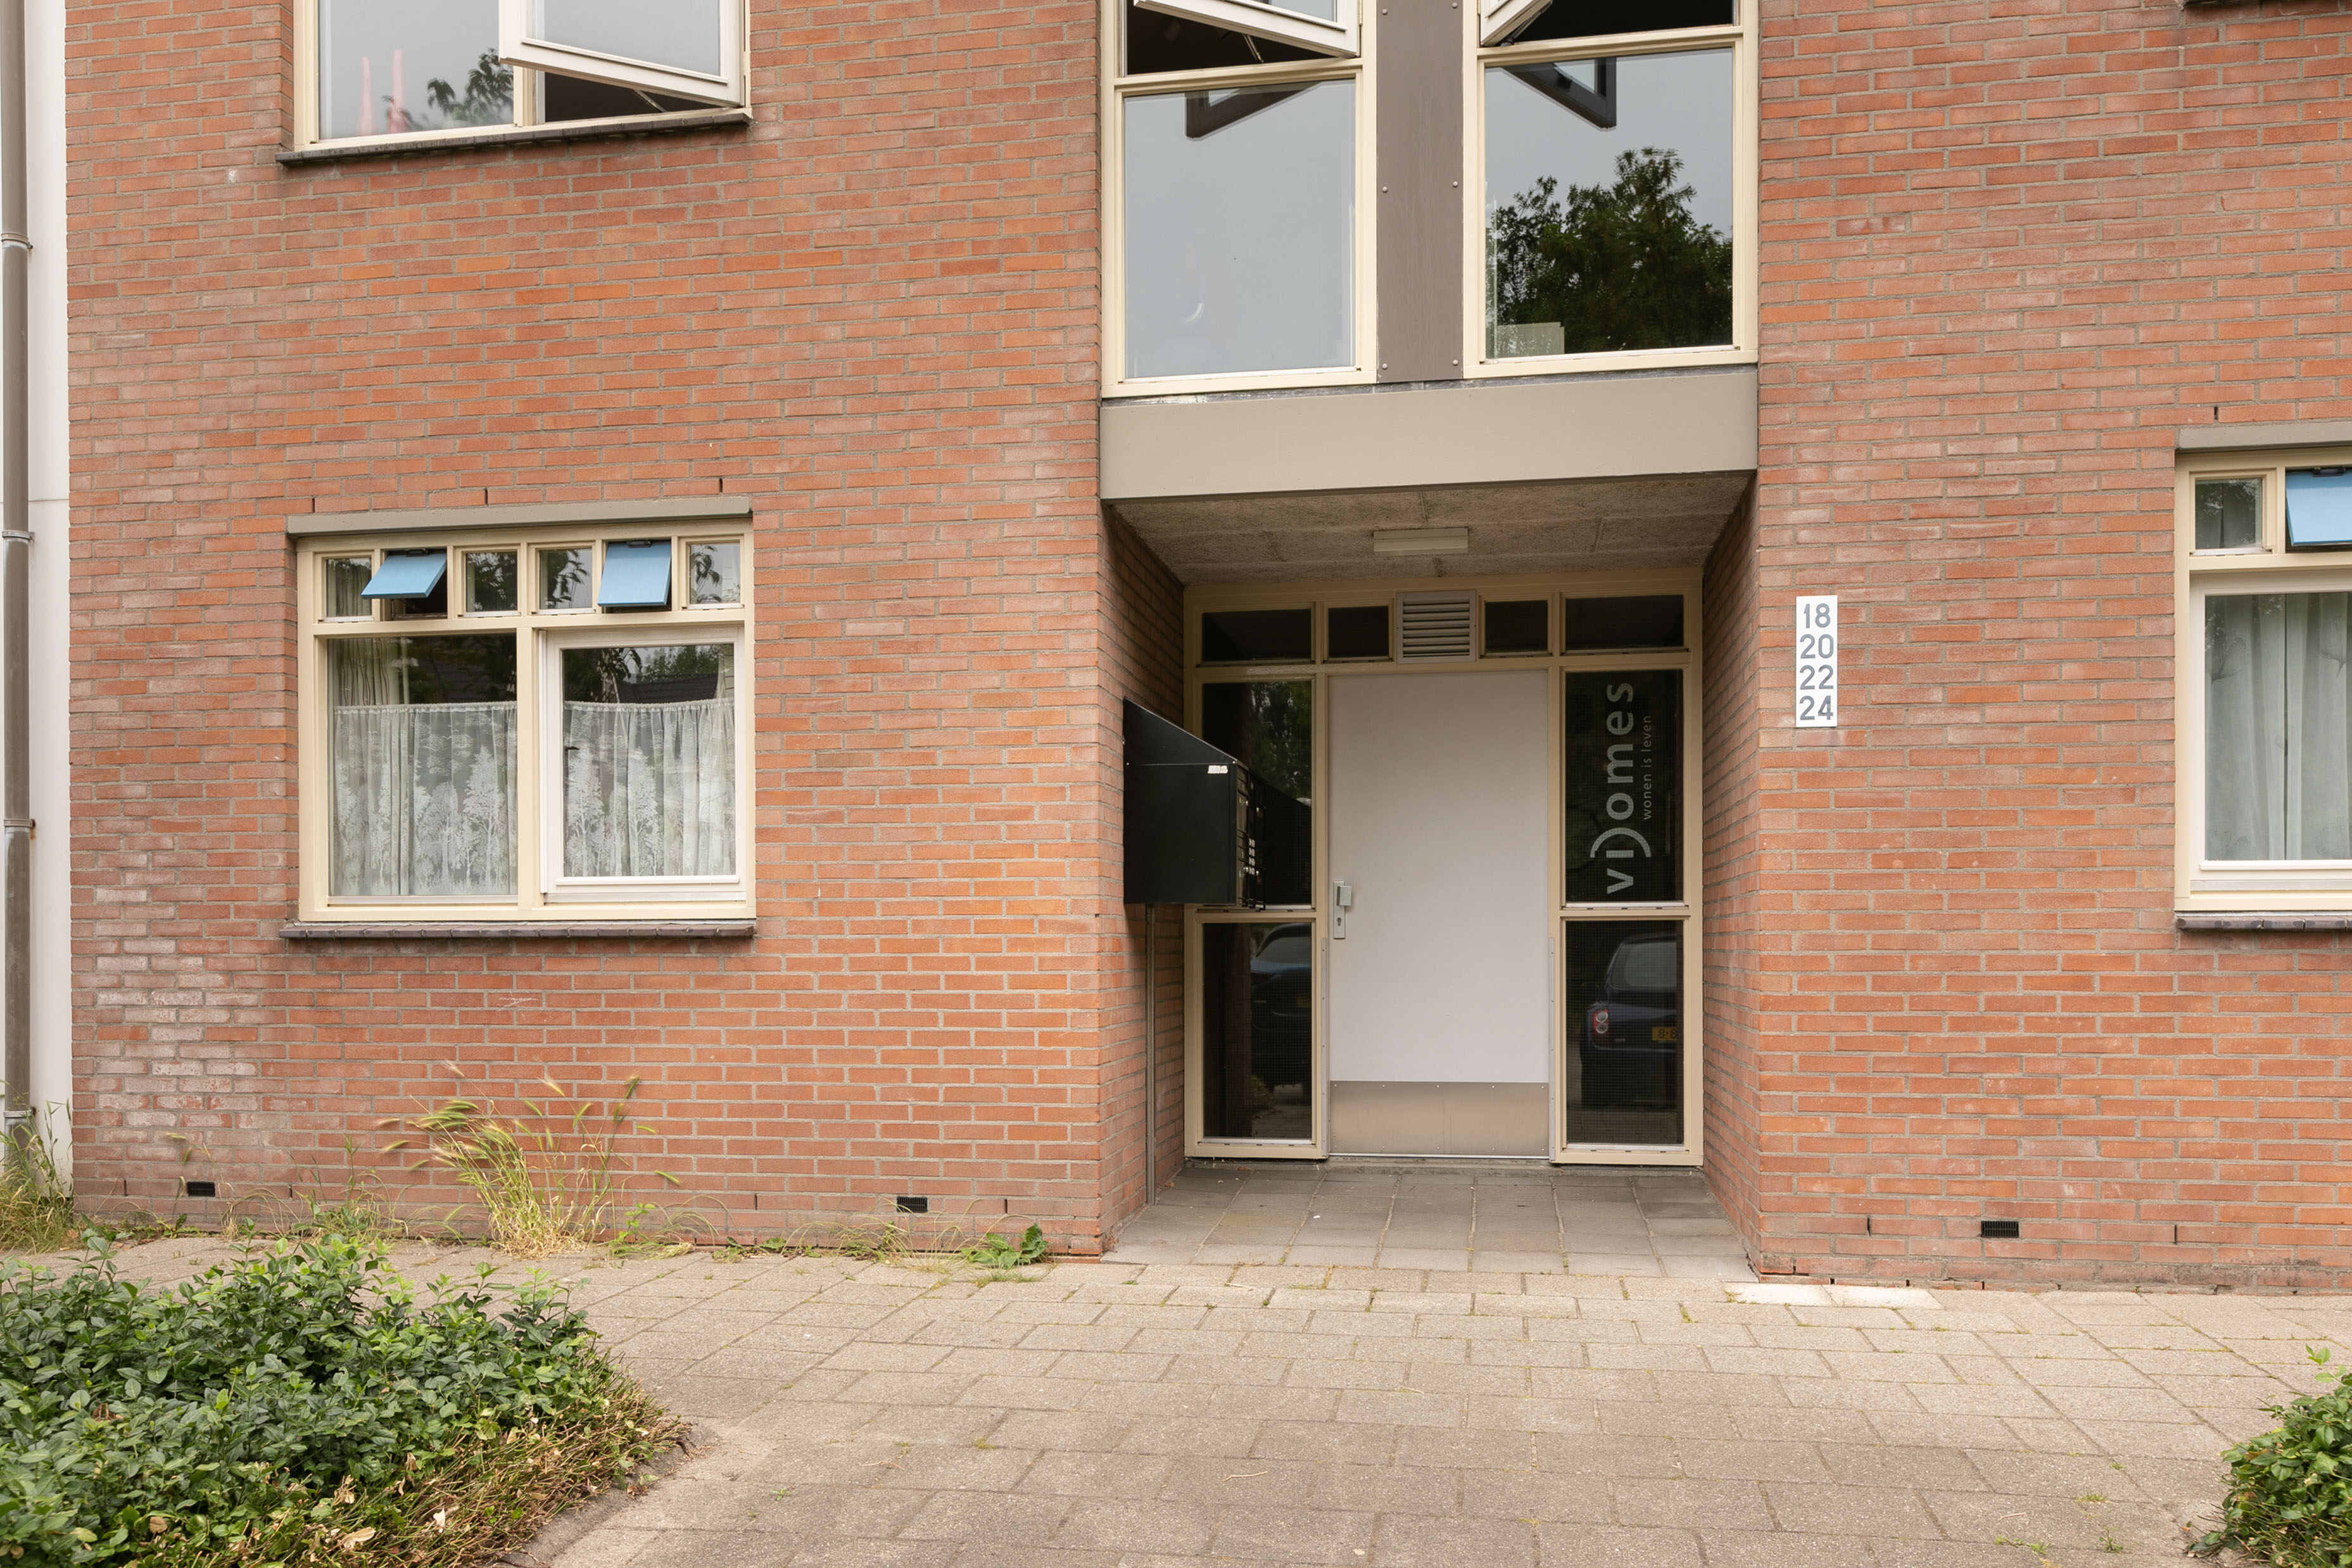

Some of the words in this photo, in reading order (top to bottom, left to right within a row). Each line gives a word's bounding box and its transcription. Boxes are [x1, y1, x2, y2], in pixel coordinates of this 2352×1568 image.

[1804, 603, 1831, 629] 18
[1800, 634, 1834, 659] 20
[1799, 664, 1834, 690] 22
[1799, 695, 1833, 721] 24
[1641, 716, 1652, 752] leven
[1641, 758, 1652, 768] is
[1643, 774, 1652, 820] wonen
